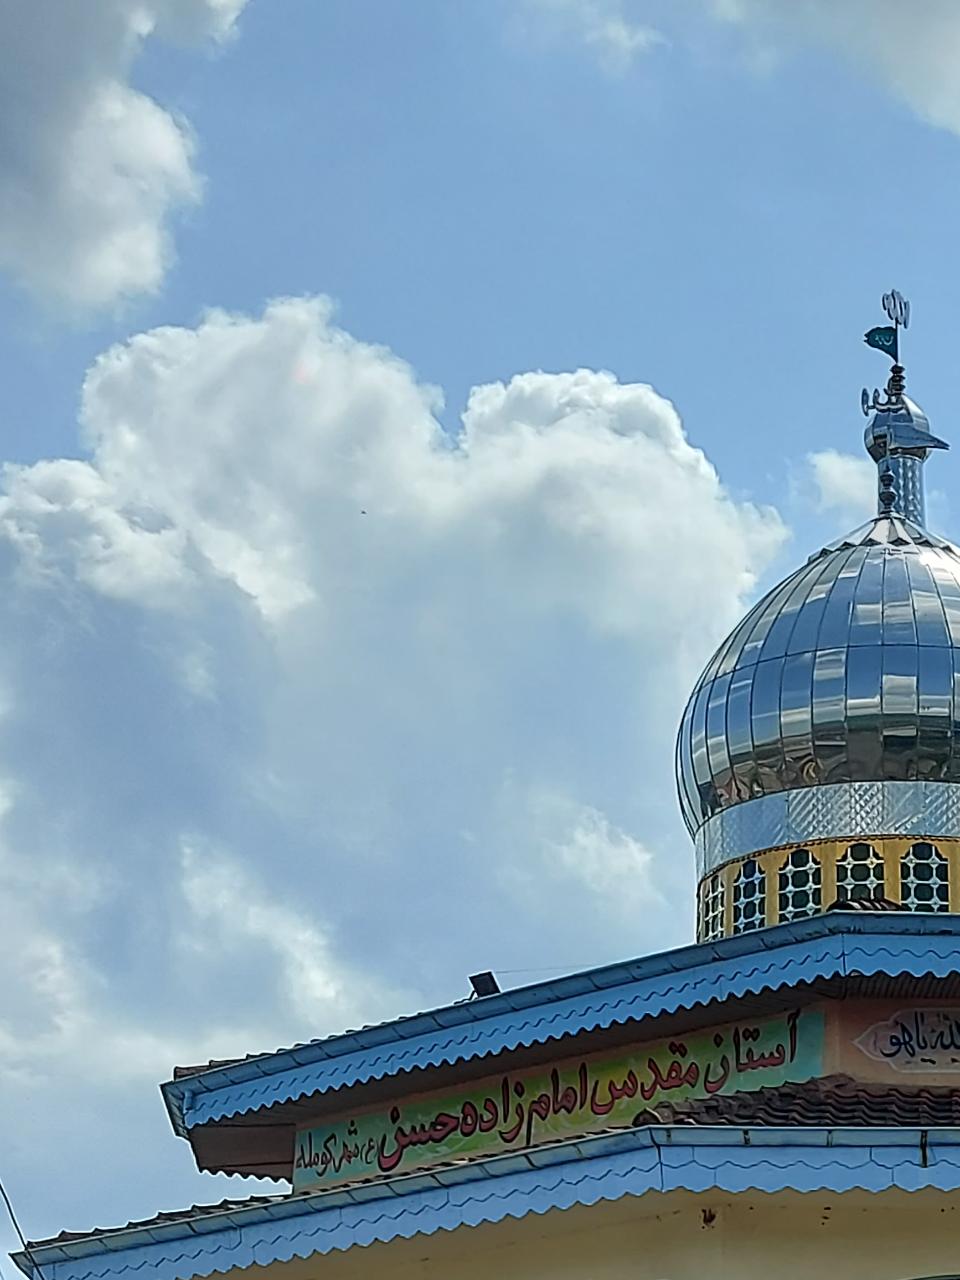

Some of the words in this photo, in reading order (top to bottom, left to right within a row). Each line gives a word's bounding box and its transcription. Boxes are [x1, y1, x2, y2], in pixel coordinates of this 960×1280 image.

[592, 1045, 699, 1118] مقدس
[703, 1010, 800, 1094] آستان
[377, 1106, 460, 1173] حسن
